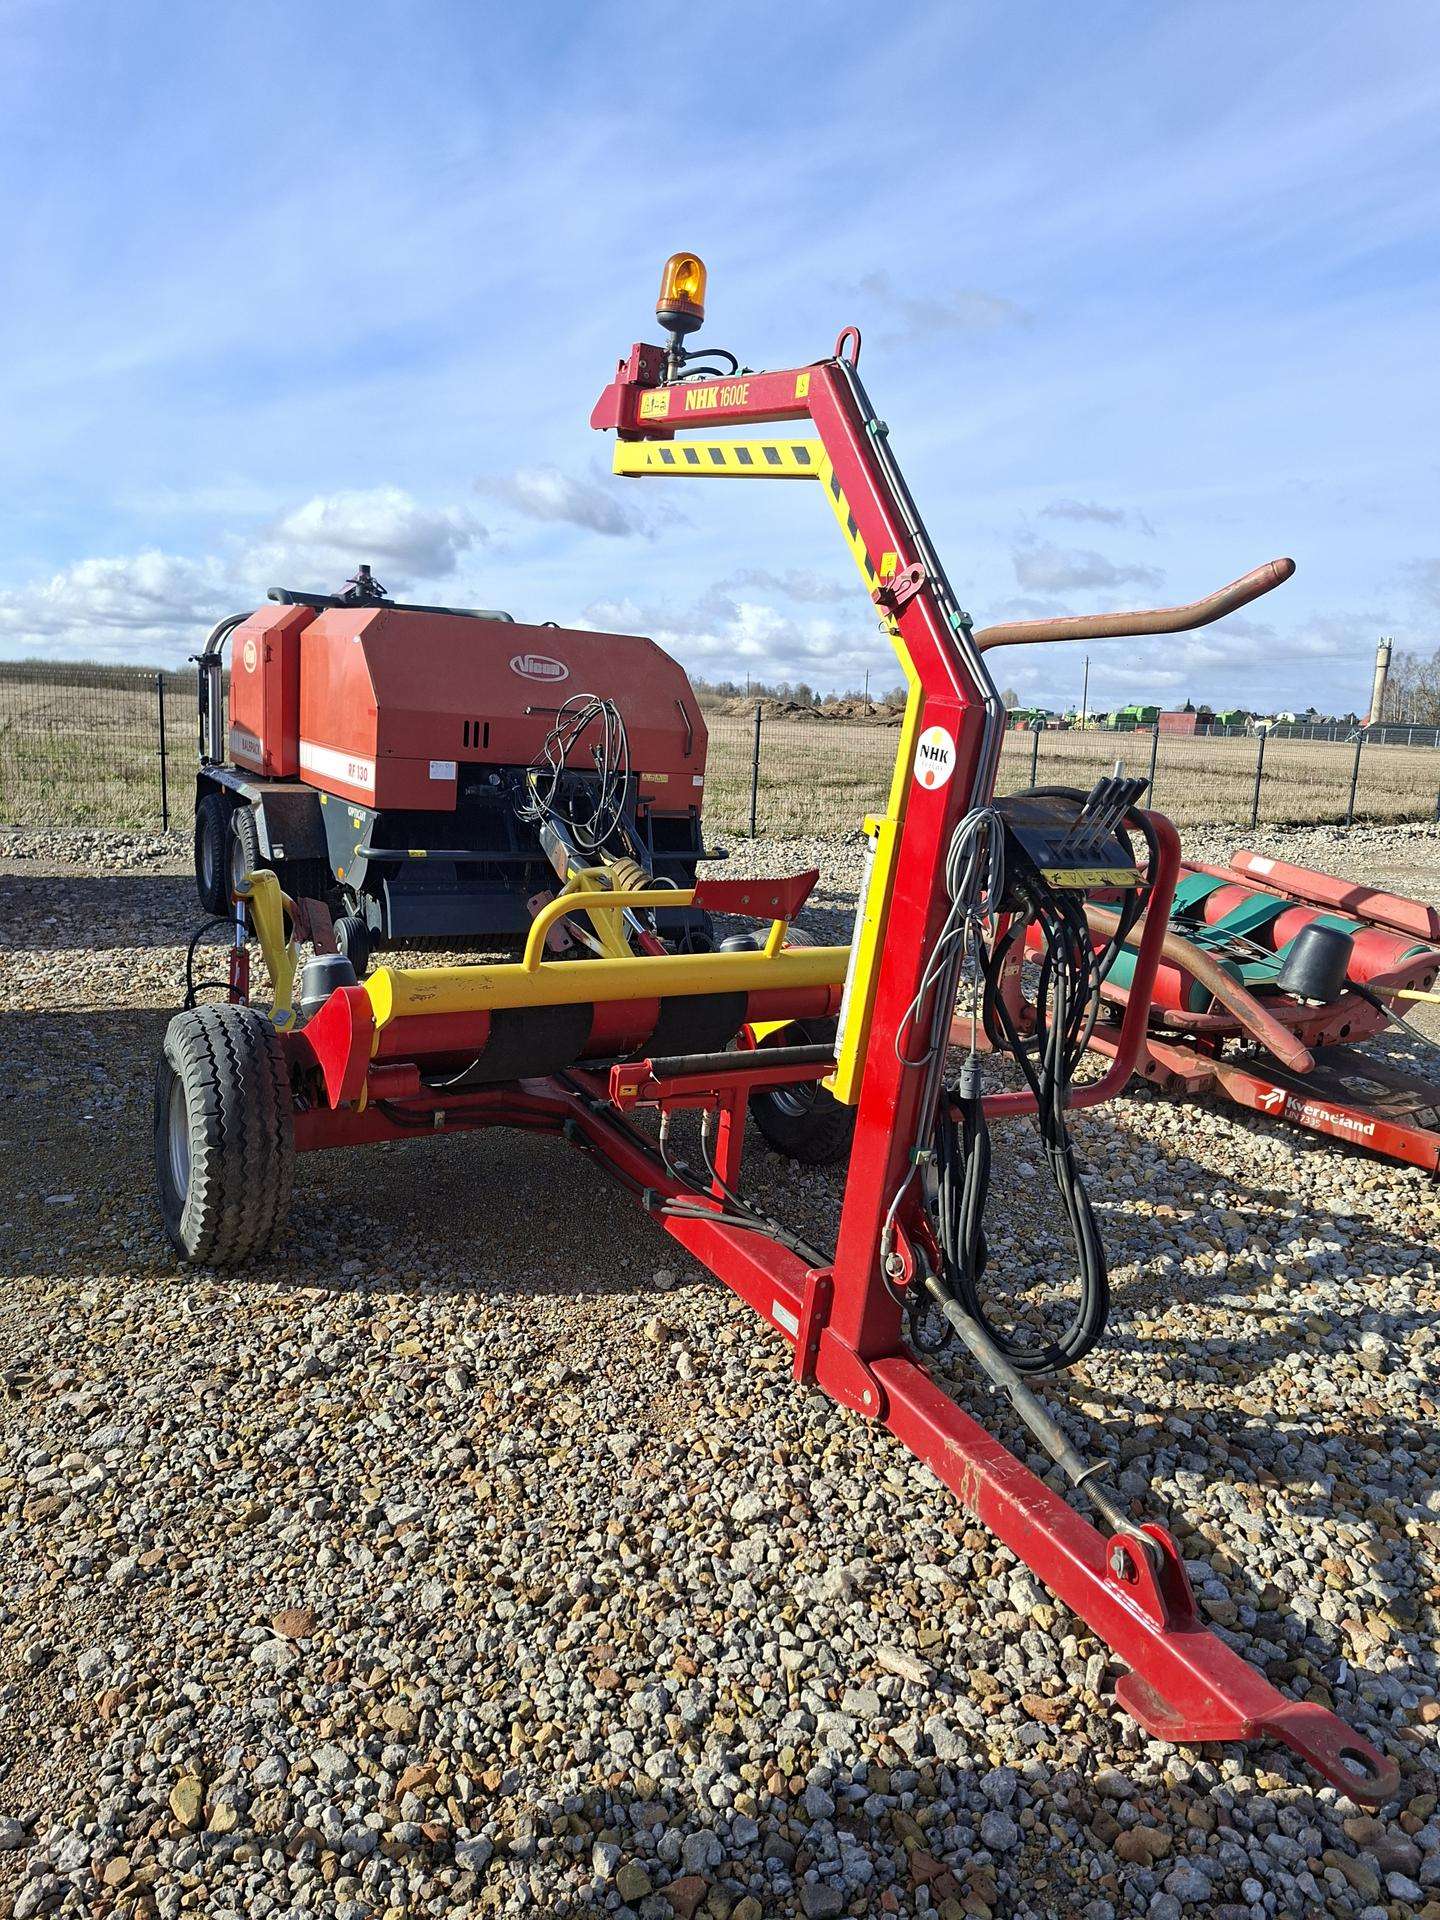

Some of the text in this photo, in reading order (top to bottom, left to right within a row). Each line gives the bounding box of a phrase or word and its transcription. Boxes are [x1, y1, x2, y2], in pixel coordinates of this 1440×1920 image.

[685, 383, 750, 411] NHK 1600E
[919, 744, 949, 764] NHK
[348, 763, 368, 781] RF 130
